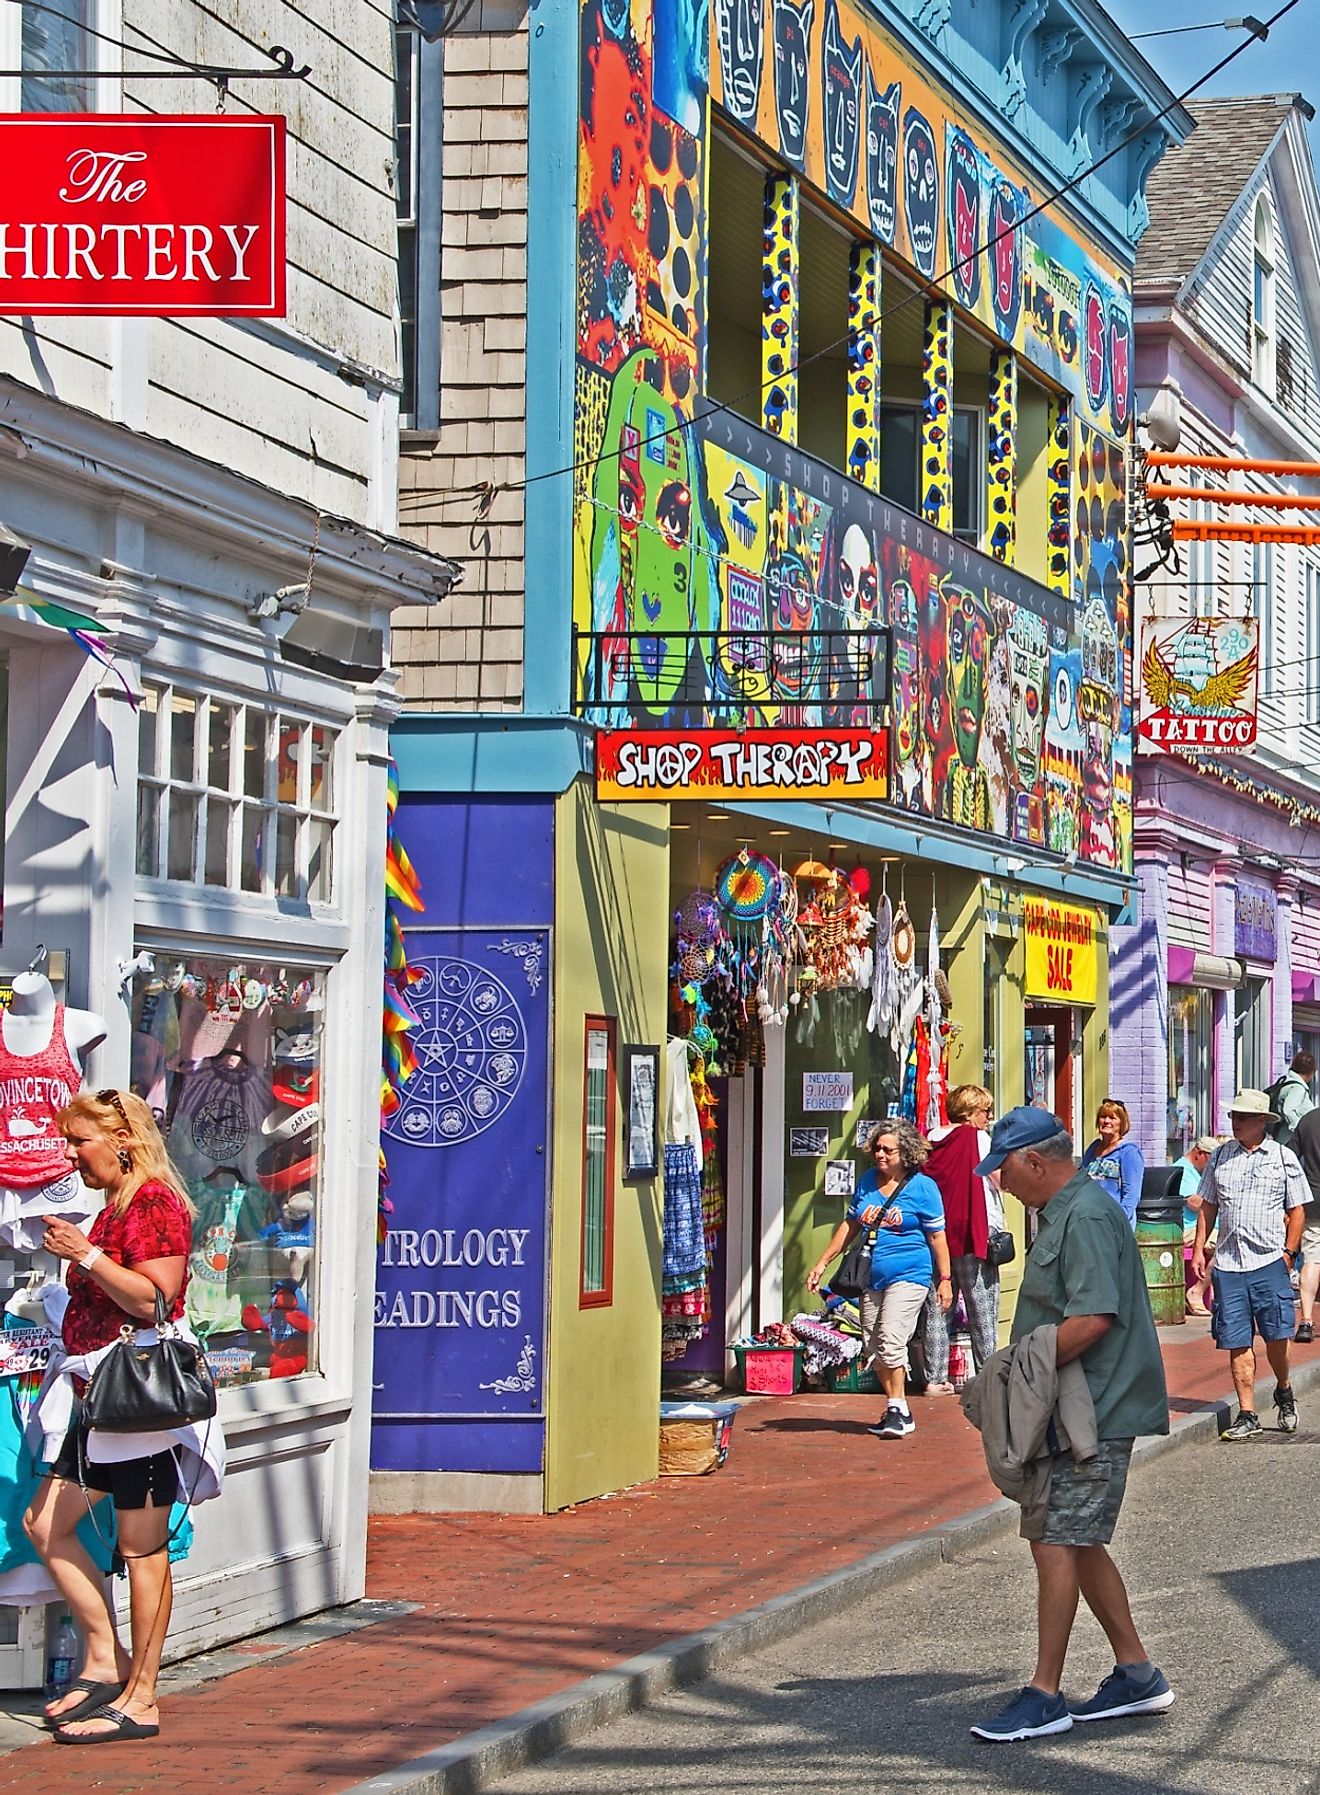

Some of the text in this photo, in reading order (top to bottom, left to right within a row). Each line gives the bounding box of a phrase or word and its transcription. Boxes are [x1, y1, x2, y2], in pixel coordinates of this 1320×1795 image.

[59, 148, 148, 203] The
[0, 222, 260, 282] HIRTERY
[866, 500, 969, 574] THERAPY
[673, 561, 687, 594] 3
[1147, 718, 1253, 743] TATTOO
[616, 740, 873, 788] SHOP THERAPY
[1047, 944, 1073, 992] SALE
[808, 1074, 841, 1084] NEVER
[806, 1099, 846, 1109] FORGET
[291, 1111, 309, 1133] CAPE
[382, 1229, 530, 1267] TROLOGY
[374, 1290, 521, 1328] EADINGS
[9, 1337, 50, 1350] SALE
[29, 1347, 50, 1369] 29
